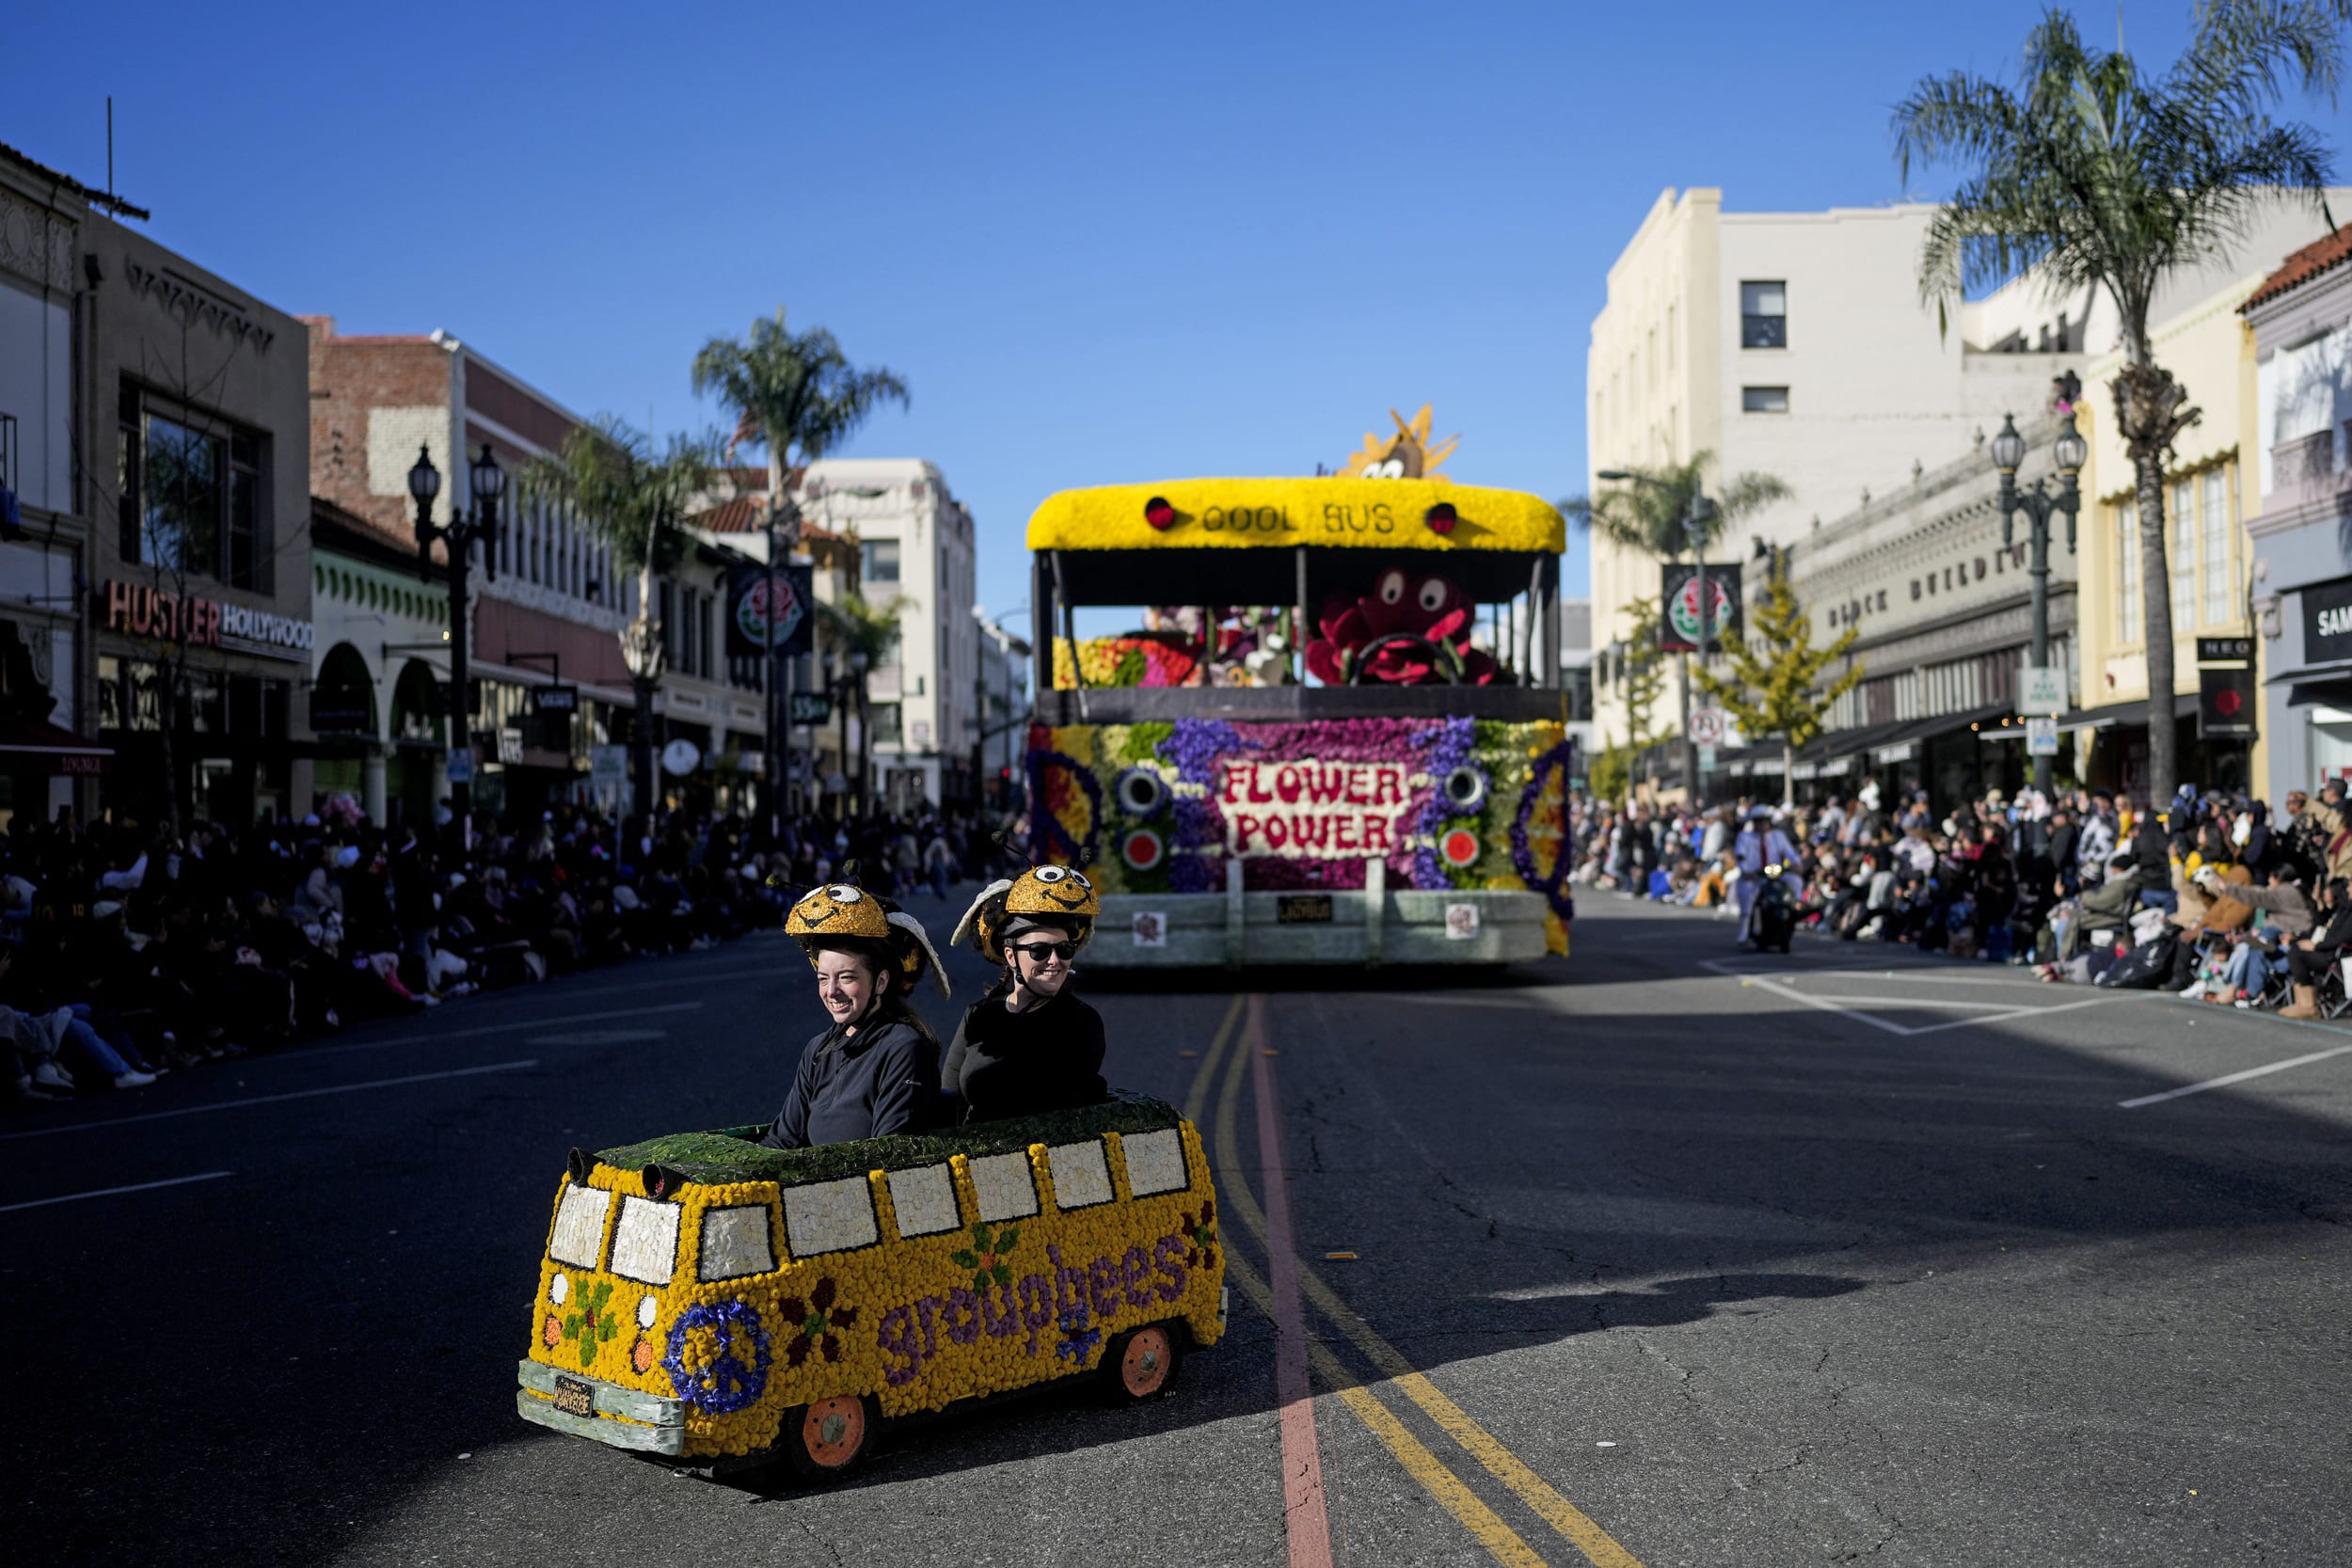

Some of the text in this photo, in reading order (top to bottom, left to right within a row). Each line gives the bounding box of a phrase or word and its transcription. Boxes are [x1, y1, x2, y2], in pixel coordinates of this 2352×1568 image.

[1322, 502, 1395, 534] BUS
[106, 578, 313, 650] HUSTLER HOLLYWOOD
[1828, 589, 1888, 628] BLOCK
[2204, 640, 2249, 655] NEO
[1223, 764, 1404, 806] FLOWER
[1235, 811, 1390, 852] POWER
[877, 1232, 1187, 1386] groupbees
